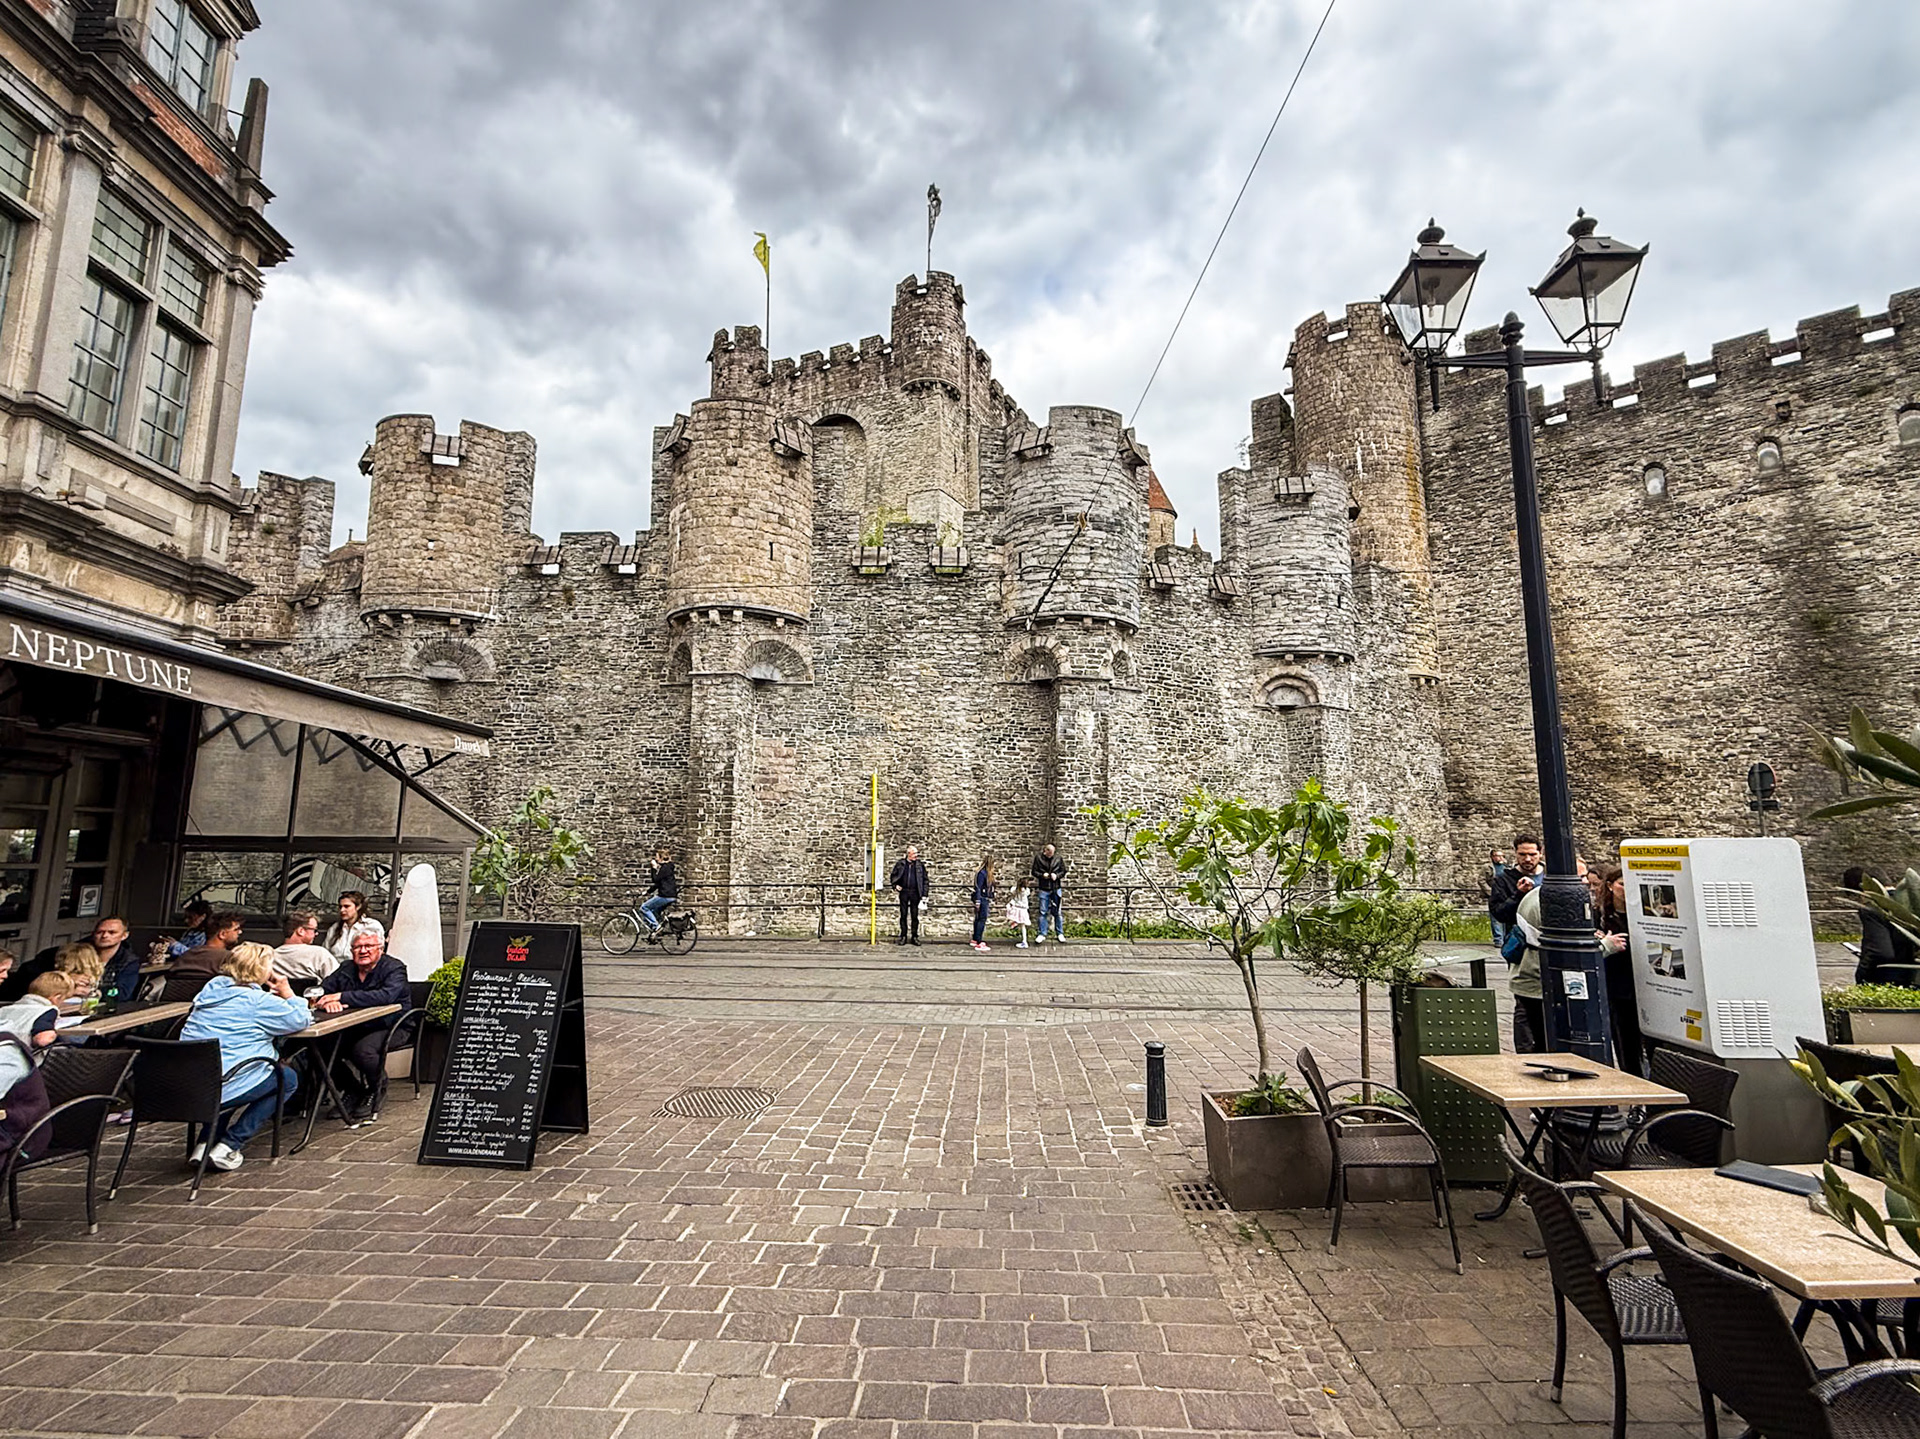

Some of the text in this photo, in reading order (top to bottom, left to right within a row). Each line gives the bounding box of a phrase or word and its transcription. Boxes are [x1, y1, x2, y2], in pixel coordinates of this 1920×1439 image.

[8, 623, 192, 694] NEPTUNE
[454, 736, 481, 753] Duvel
[472, 970, 513, 982] Restaurant
